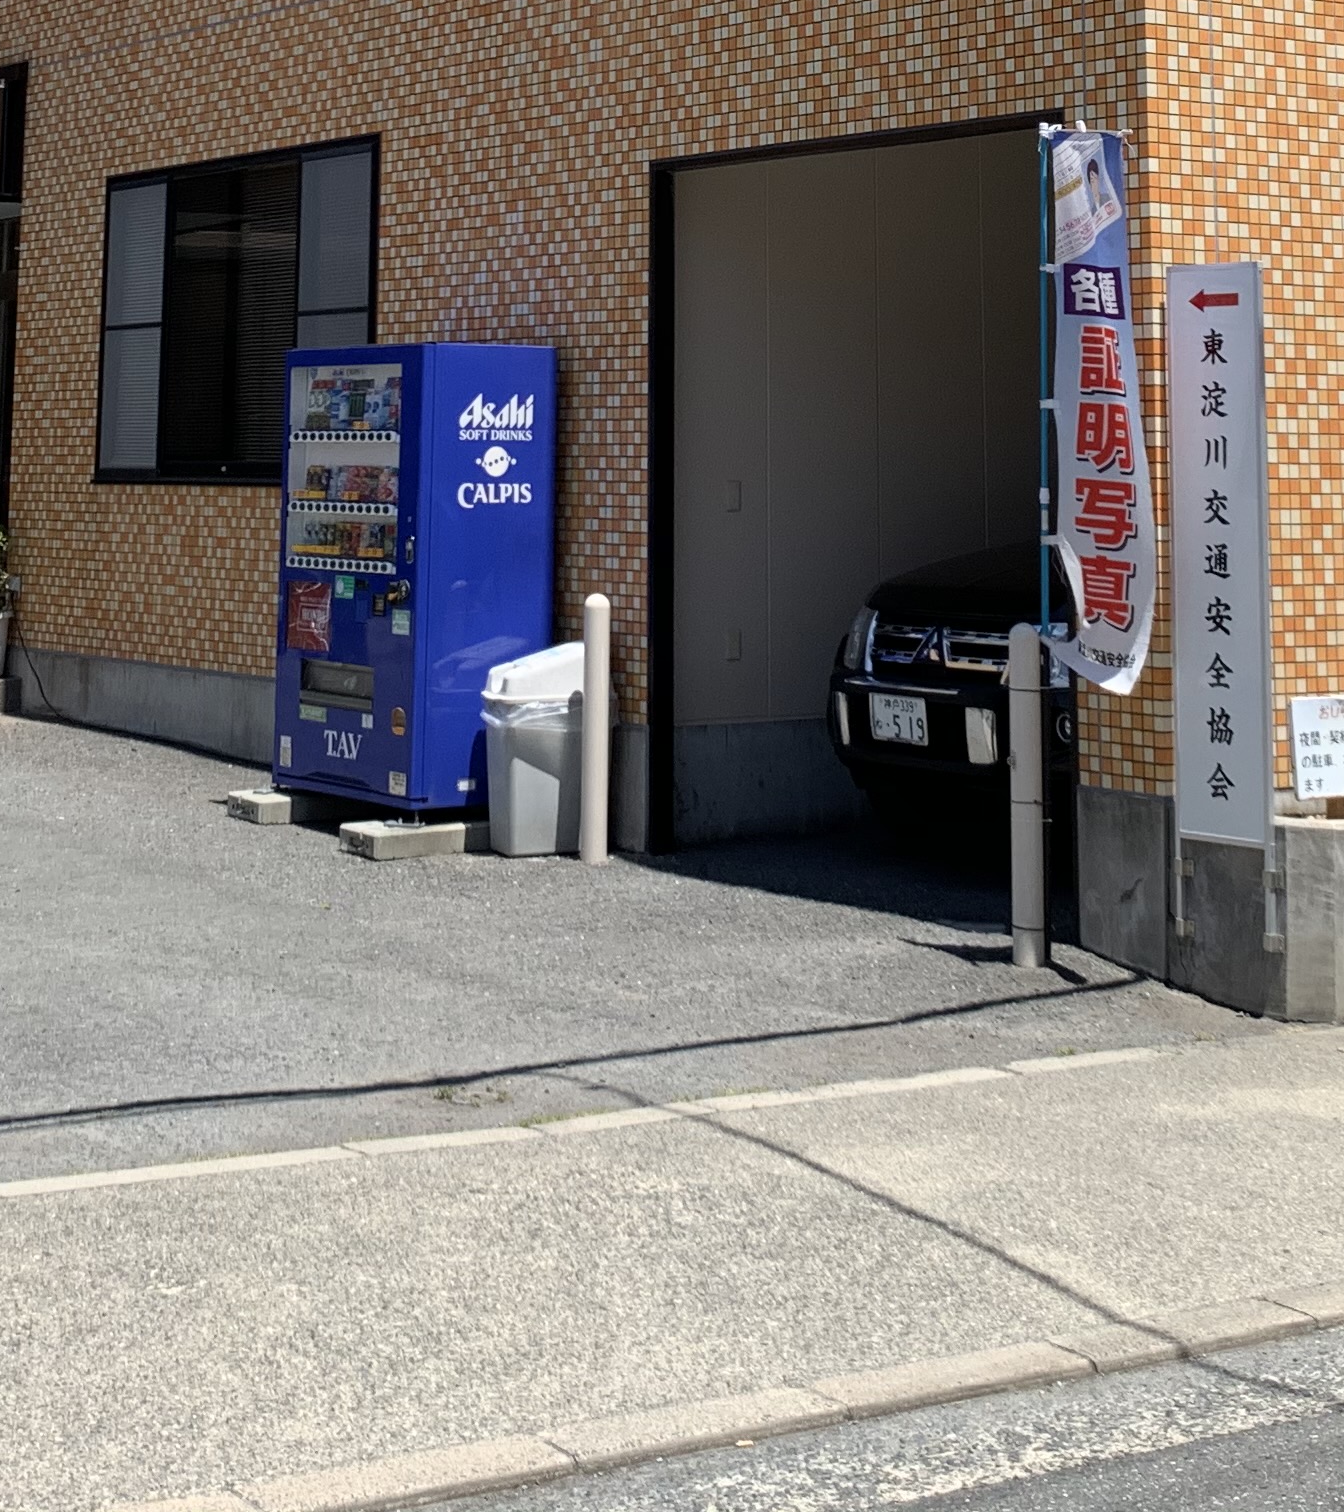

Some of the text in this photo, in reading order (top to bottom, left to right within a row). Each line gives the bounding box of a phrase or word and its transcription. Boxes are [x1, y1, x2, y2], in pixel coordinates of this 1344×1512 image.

[1070, 268, 1120, 316] 各種
[459, 393, 534, 429] Asahi
[459, 429, 533, 442] SOFT DRINKS
[457, 483, 532, 509] CALPIS
[1074, 324, 1137, 631] 証明写真
[1200, 328, 1236, 802] 東淀川交通安全協会
